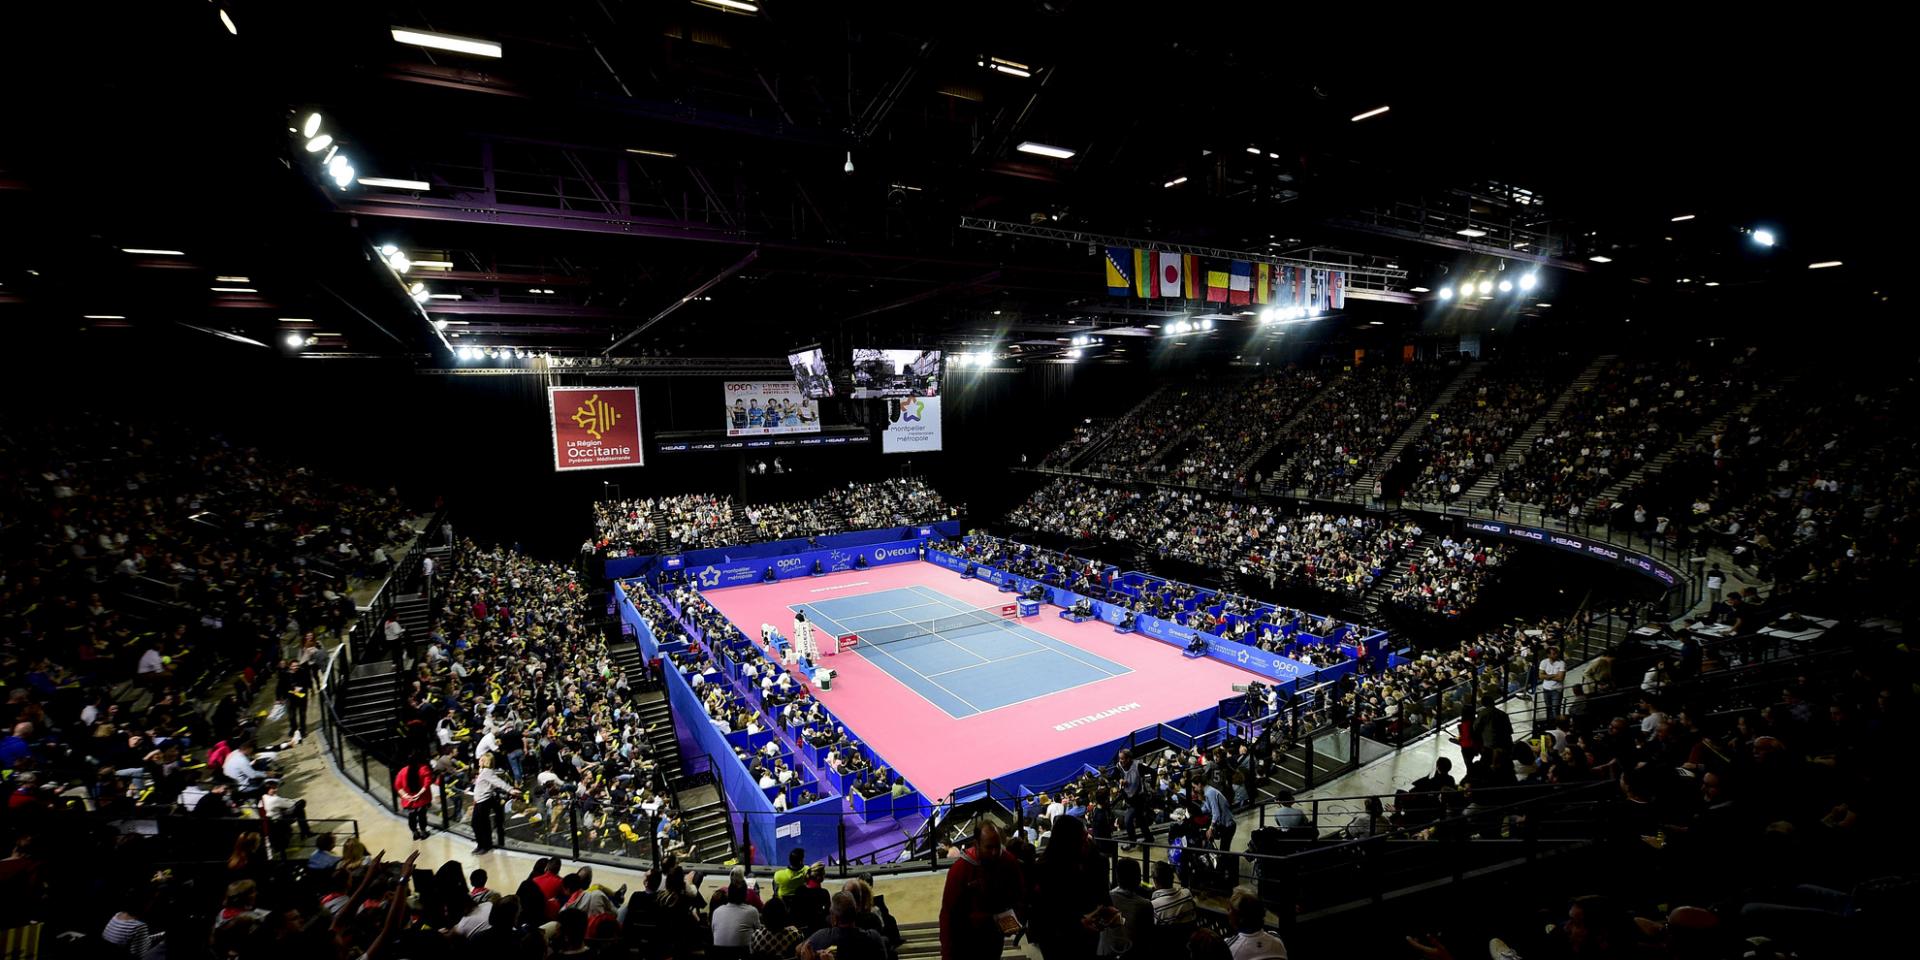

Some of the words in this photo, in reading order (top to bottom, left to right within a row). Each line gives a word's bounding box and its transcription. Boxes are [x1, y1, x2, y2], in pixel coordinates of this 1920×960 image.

[577, 438, 602, 448] Région
[568, 446, 630, 458] Occitanie
[887, 547, 916, 557] VEOLIA
[1467, 522, 1501, 533] HEAD
[1509, 528, 1543, 540] HEAD
[1551, 536, 1582, 549] HEAD
[1588, 545, 1618, 559] HEAD
[1624, 556, 1650, 571] HEAD
[1655, 568, 1674, 584] HEAD
[1053, 702, 1141, 731] MONTPELLIER
